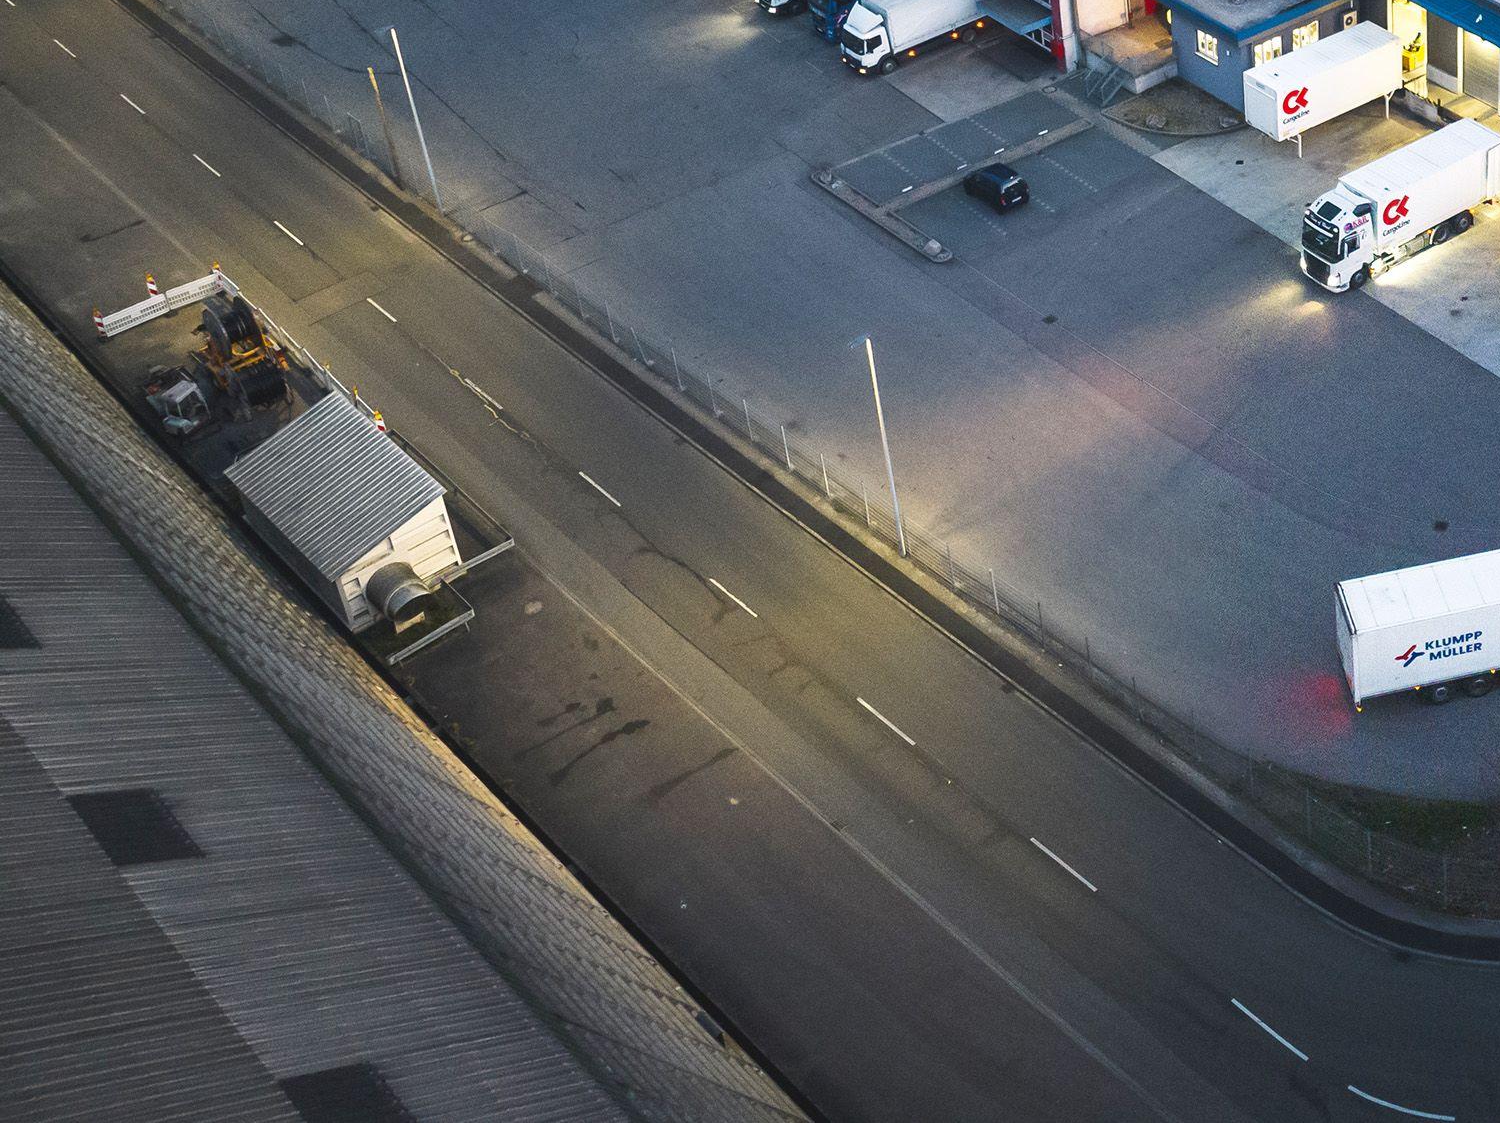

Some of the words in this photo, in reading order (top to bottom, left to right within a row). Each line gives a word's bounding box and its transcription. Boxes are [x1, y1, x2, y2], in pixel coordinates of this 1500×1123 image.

[1282, 109, 1310, 125] CargoLine
[1382, 219, 1411, 237] CargoLine
[1424, 630, 1483, 651] KLUMPP
[1429, 642, 1483, 661] MÜLLER
